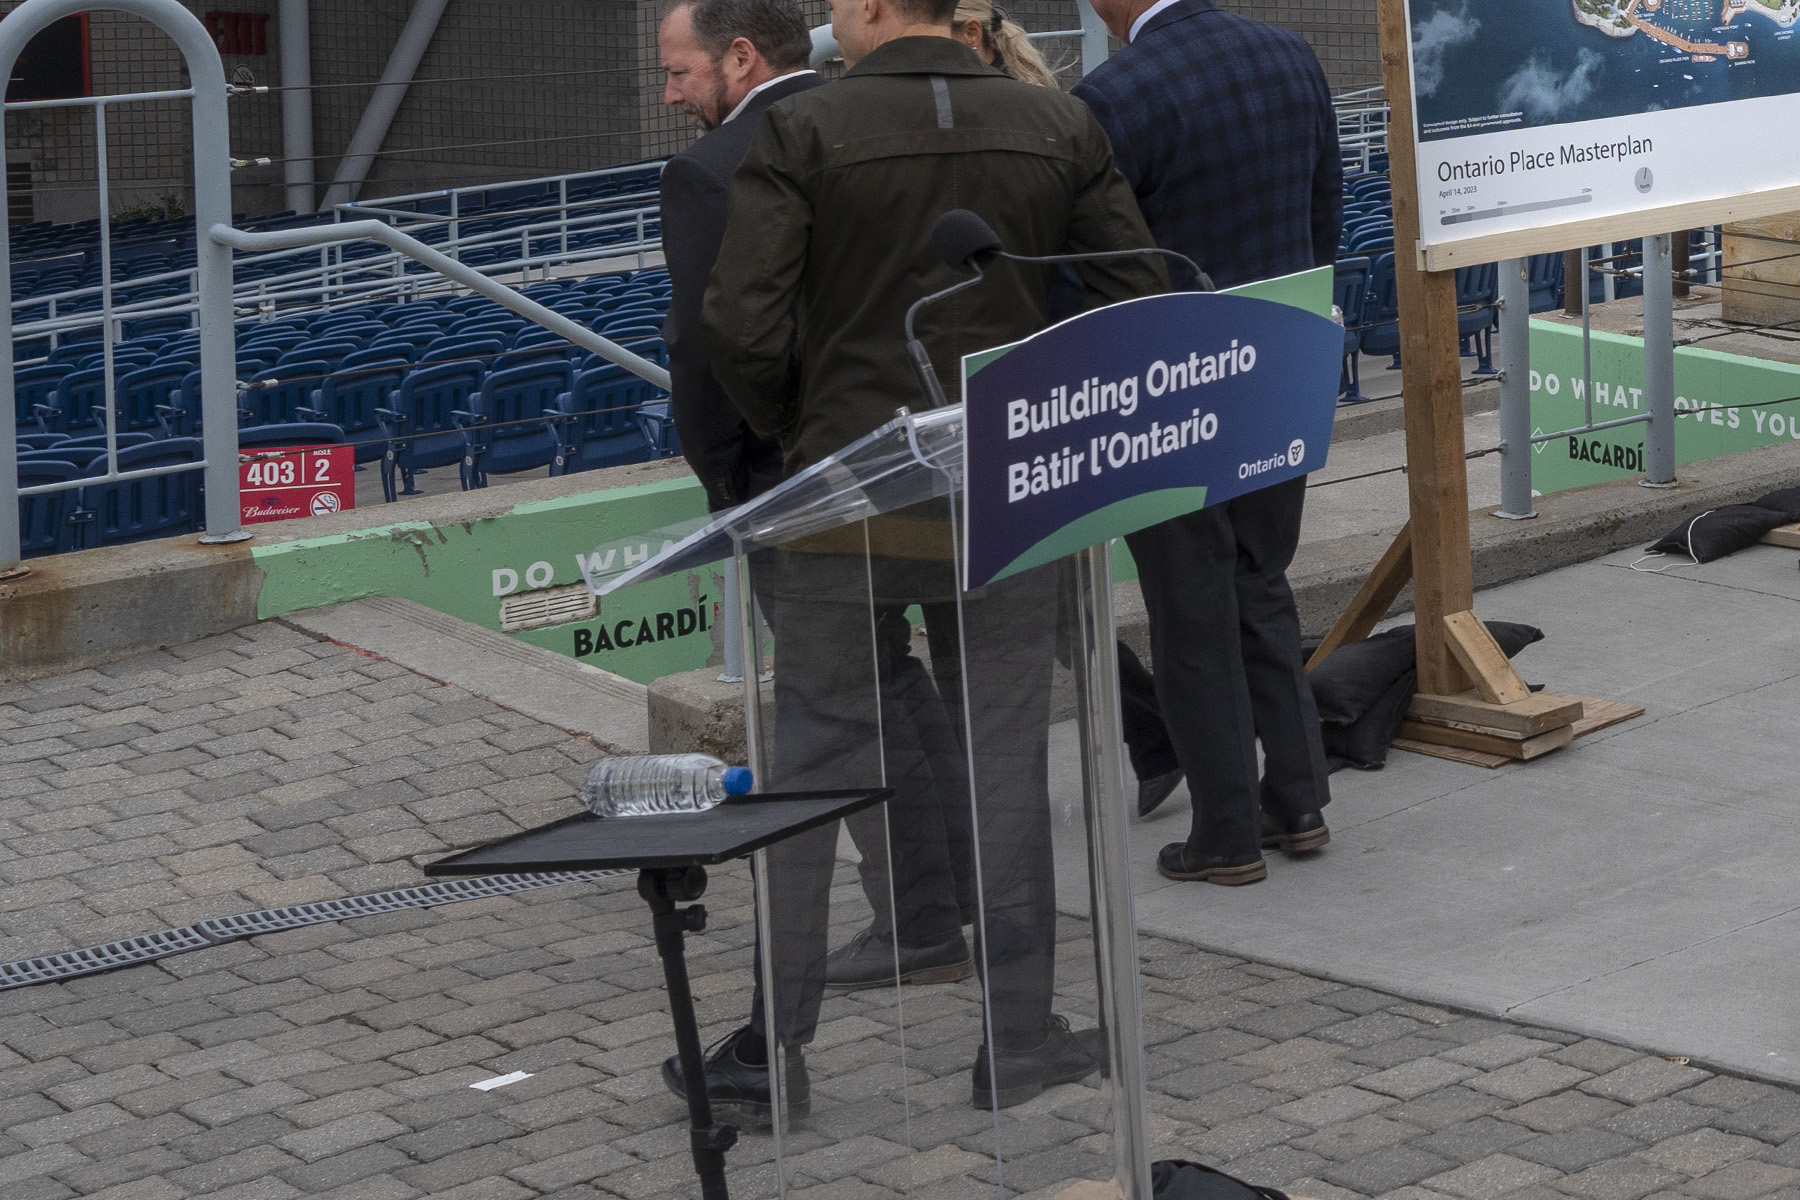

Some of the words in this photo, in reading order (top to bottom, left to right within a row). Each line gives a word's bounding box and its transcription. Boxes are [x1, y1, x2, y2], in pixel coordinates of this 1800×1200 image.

[1437, 155, 1505, 183] Ontario
[1510, 149, 1555, 173] Place
[1560, 135, 1653, 167] Masterplan
[1438, 188, 1453, 200] April
[1453, 187, 1463, 197] 14,
[1463, 185, 1478, 195] 2023
[1007, 375, 1138, 440] Building
[1146, 338, 1257, 399] Ontario
[1530, 370, 1560, 395] DO
[1571, 377, 1643, 410] WHAT
[1674, 396, 1740, 429] OVES
[313, 448, 332, 456] AISLE
[1007, 446, 1085, 503] Bâtir
[1090, 408, 1219, 477] l'Ontario
[1238, 454, 1286, 481] Ontario
[247, 461, 295, 486] 403
[315, 459, 330, 482] 2
[242, 505, 301, 518] Budweiser
[493, 560, 554, 596] DO
